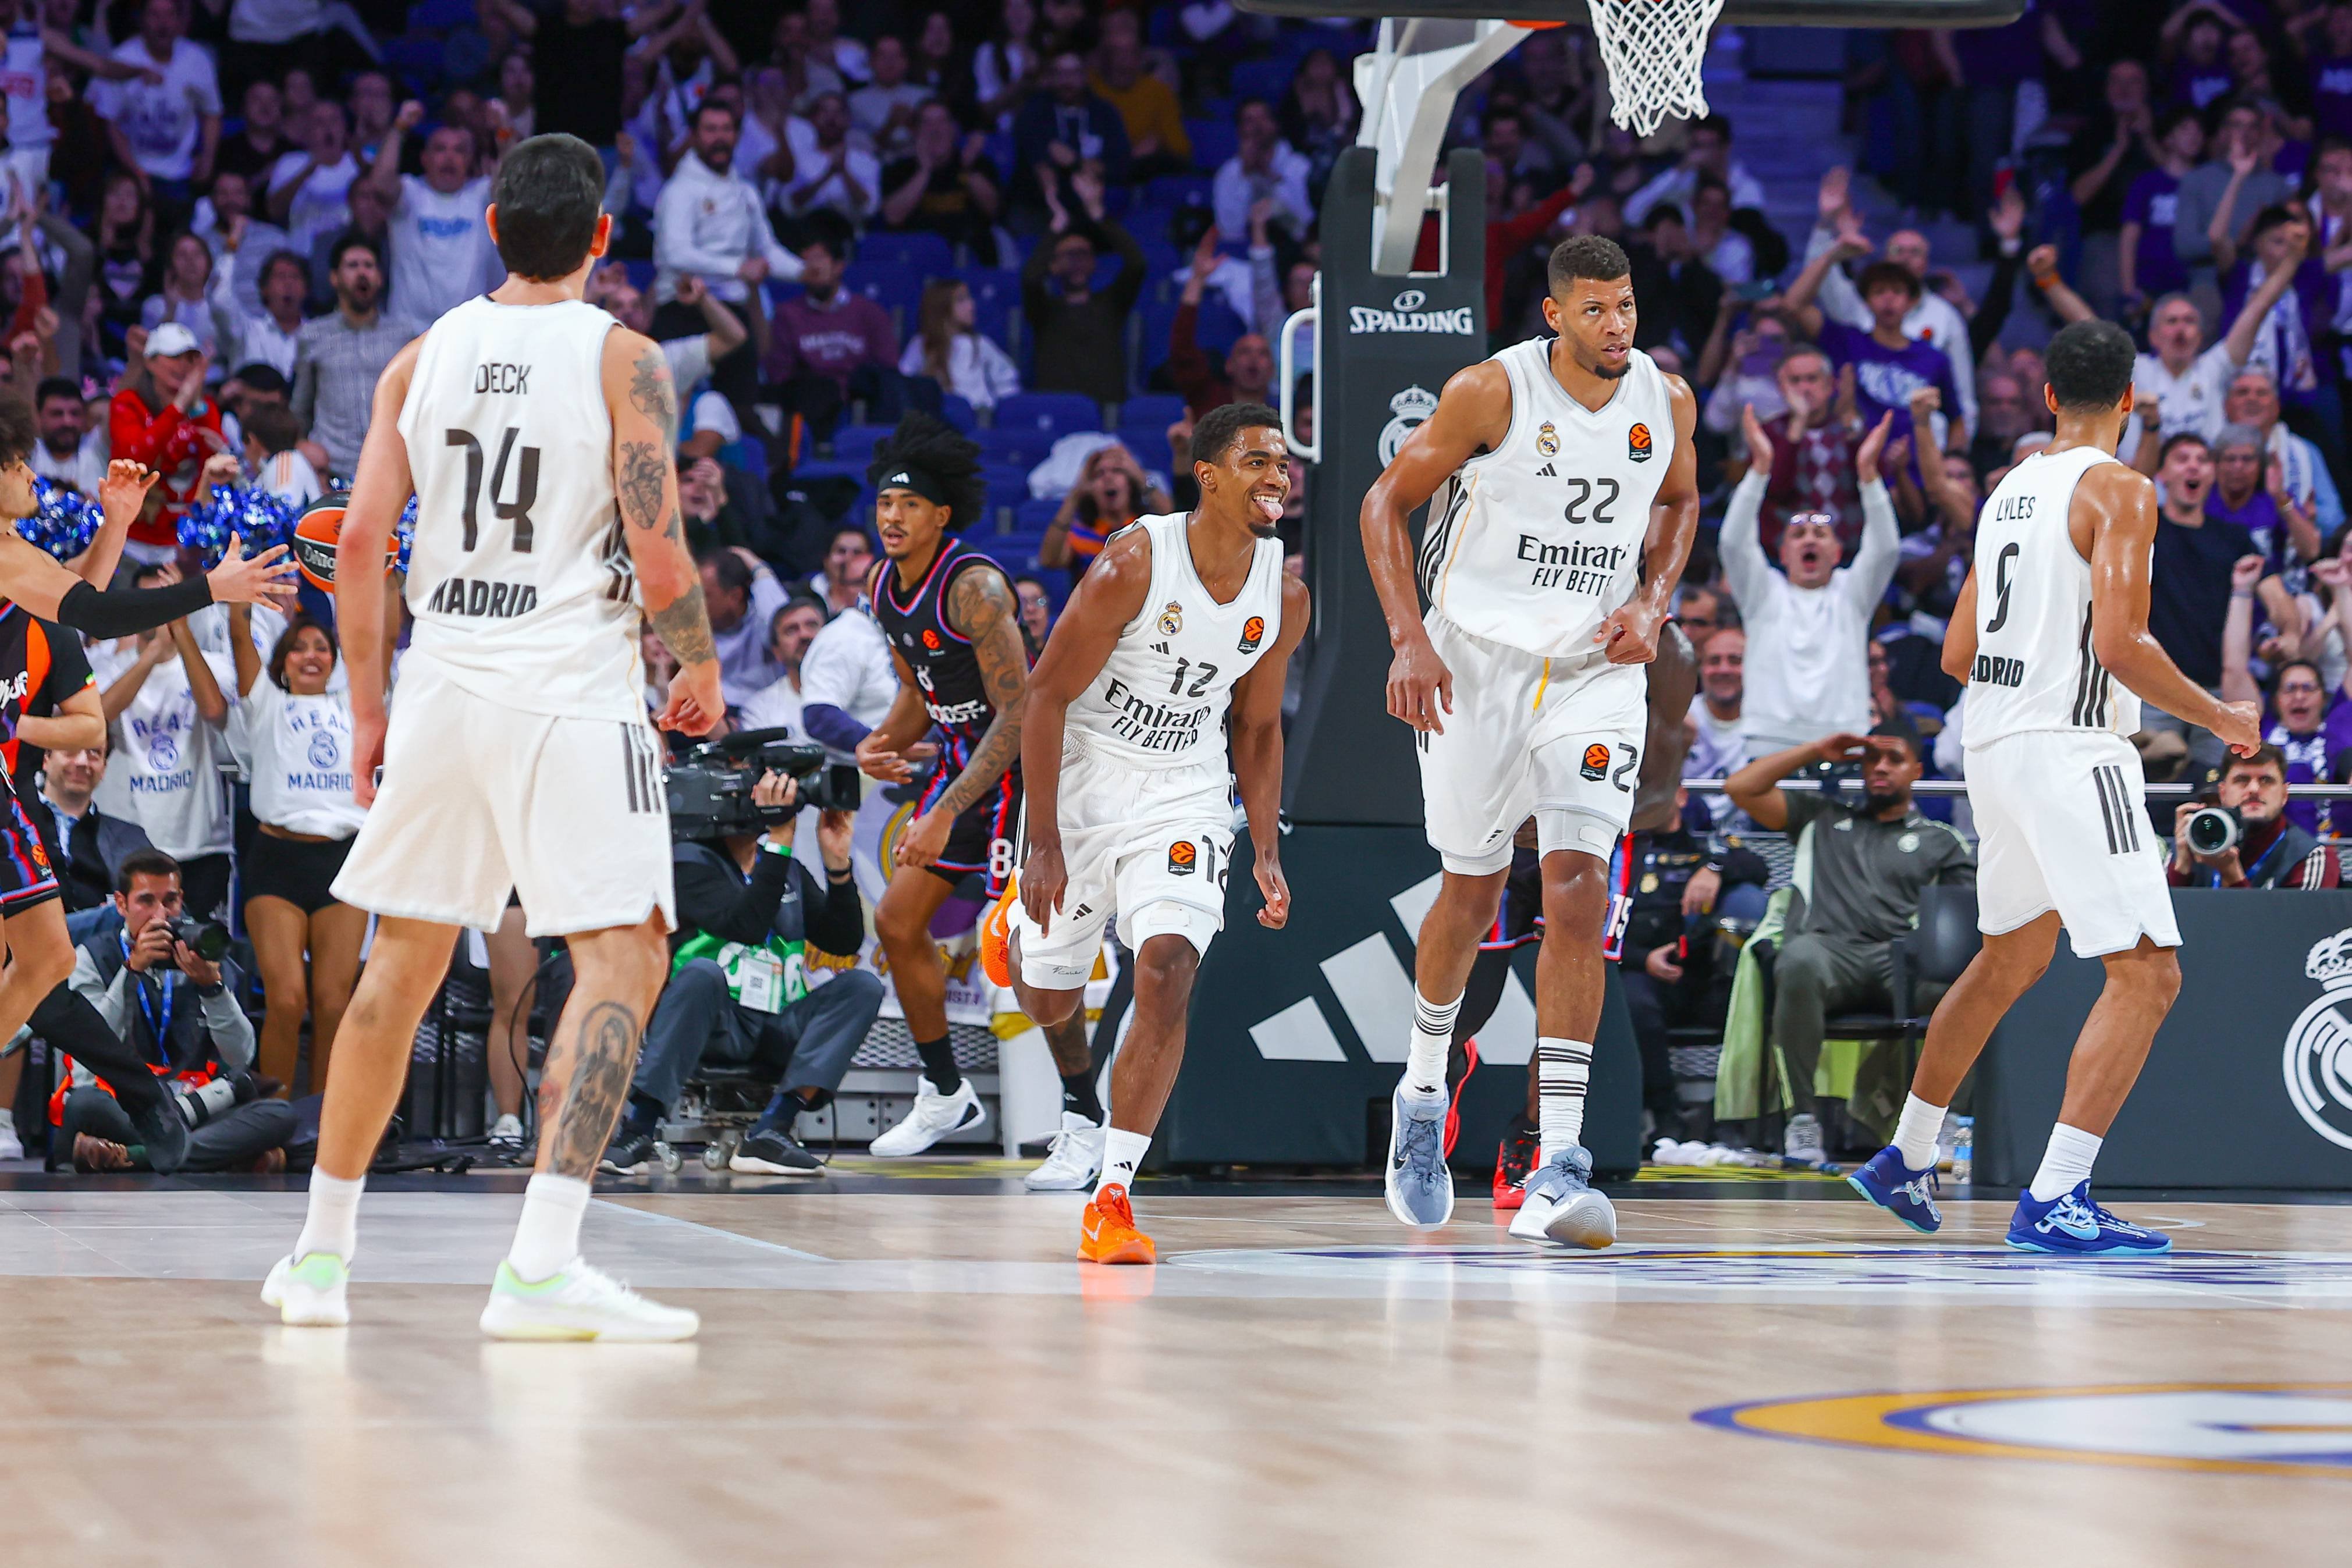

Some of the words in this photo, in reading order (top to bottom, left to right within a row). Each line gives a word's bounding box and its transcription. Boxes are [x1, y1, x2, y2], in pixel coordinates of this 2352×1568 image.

[1349, 306, 1474, 335] SPALDING
[474, 363, 532, 394] DECK
[445, 427, 541, 554] 14
[1565, 478, 1620, 524] 22
[1996, 496, 2036, 521] LYLES
[1517, 534, 1630, 571] Emirat
[427, 577, 537, 618] MADRID
[1532, 567, 1564, 588] FLY
[1565, 569, 1614, 596] BETT
[1169, 656, 1218, 698] 12
[1969, 654, 2024, 688] ADRID
[132, 712, 193, 738] REAL
[290, 709, 350, 734] REAL
[1111, 715, 1144, 741] FLY
[1141, 728, 1198, 752] BETTER
[130, 770, 192, 792] MADRID
[287, 772, 354, 792] MADRID
[989, 838, 1014, 879] 8
[1607, 893, 1634, 940] 15
